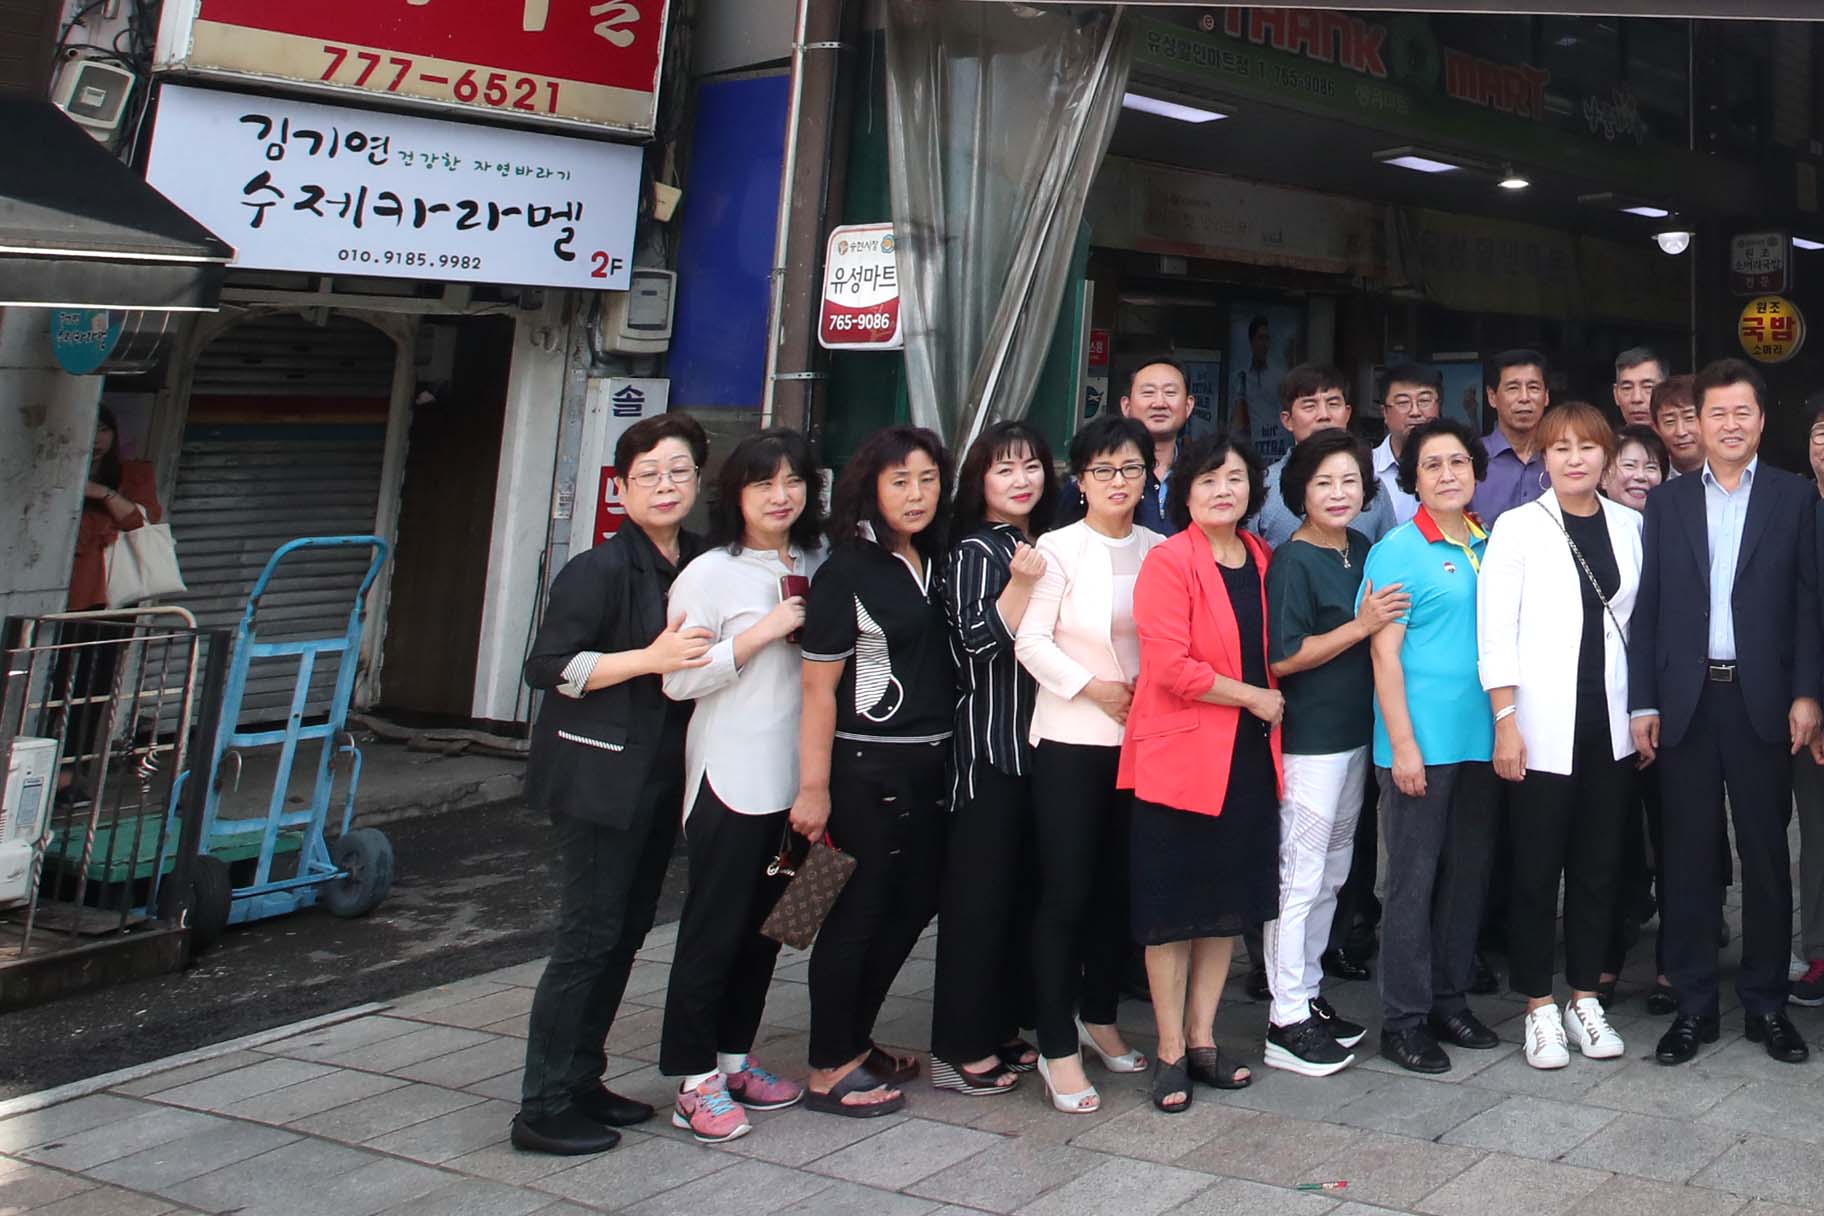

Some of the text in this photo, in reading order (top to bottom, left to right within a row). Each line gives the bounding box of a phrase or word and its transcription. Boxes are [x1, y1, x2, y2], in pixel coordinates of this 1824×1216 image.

[321, 45, 559, 114] 777-6521
[239, 113, 571, 182] 김기연 건강한 자연바라기
[240, 170, 584, 262] 수제카라멜
[338, 248, 481, 271] 010.9185.9982
[590, 250, 623, 279] 2F
[830, 265, 897, 294] 유성마트
[828, 313, 890, 330] 765-9086
[1756, 301, 1780, 313] 원조
[1742, 316, 1795, 342] 국밥
